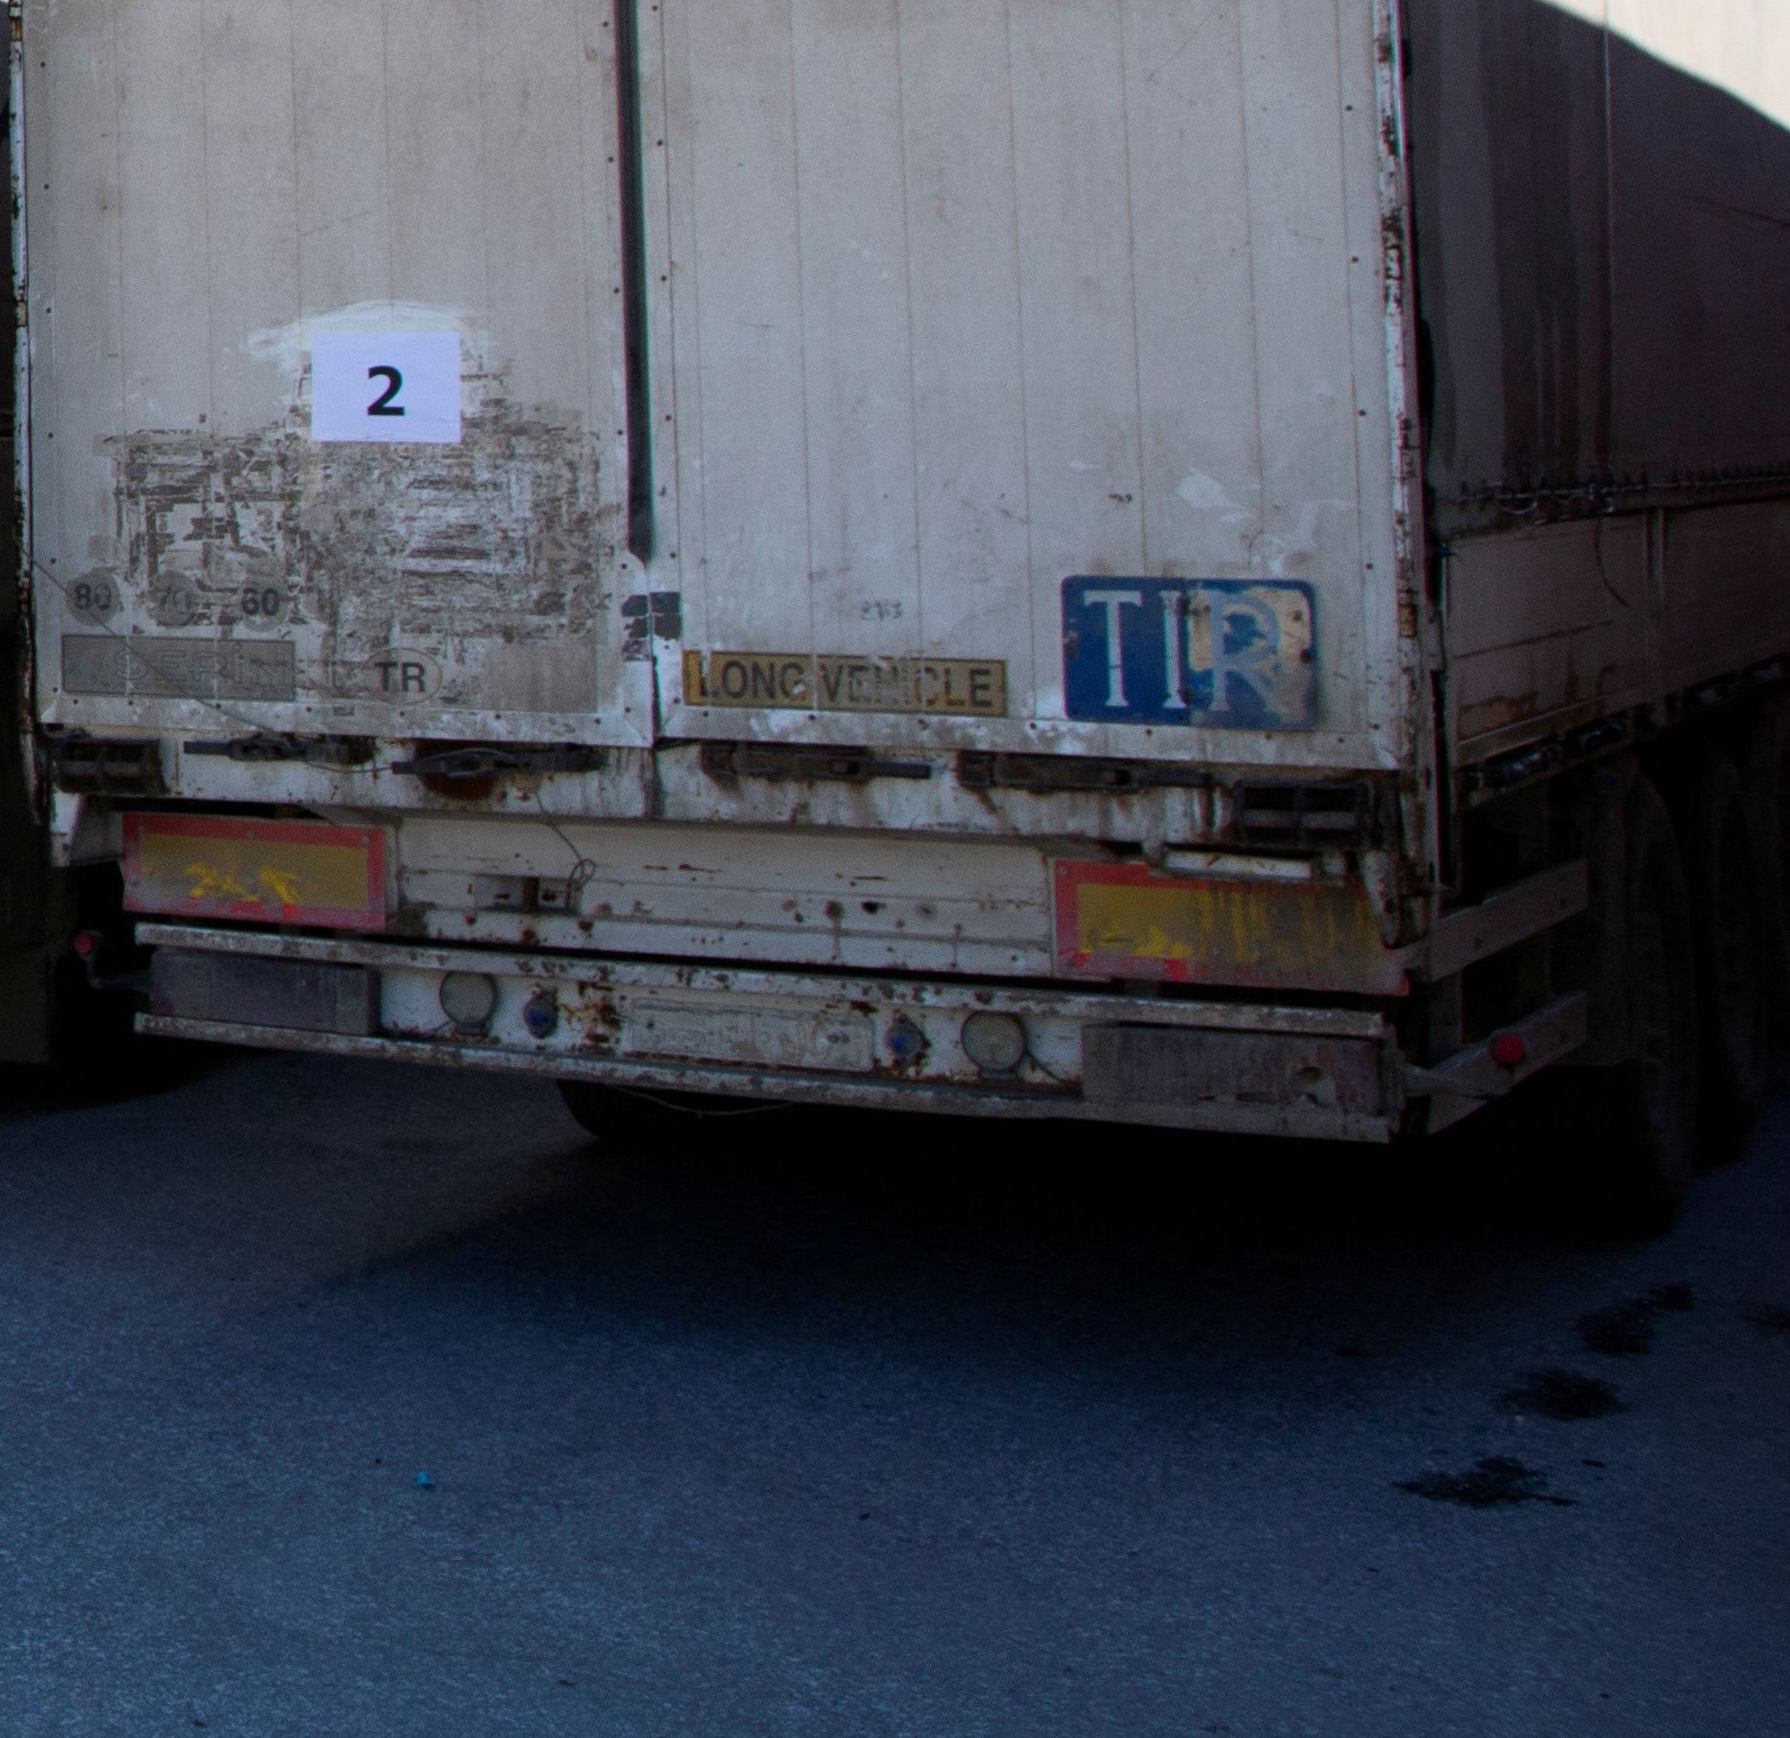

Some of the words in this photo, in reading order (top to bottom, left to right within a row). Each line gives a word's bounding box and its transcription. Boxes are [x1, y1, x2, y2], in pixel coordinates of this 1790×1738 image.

[367, 365, 406, 417] 2
[74, 582, 112, 611] 80
[240, 588, 280, 616] 60
[1083, 589, 1282, 718] TIR
[374, 661, 426, 692] TR
